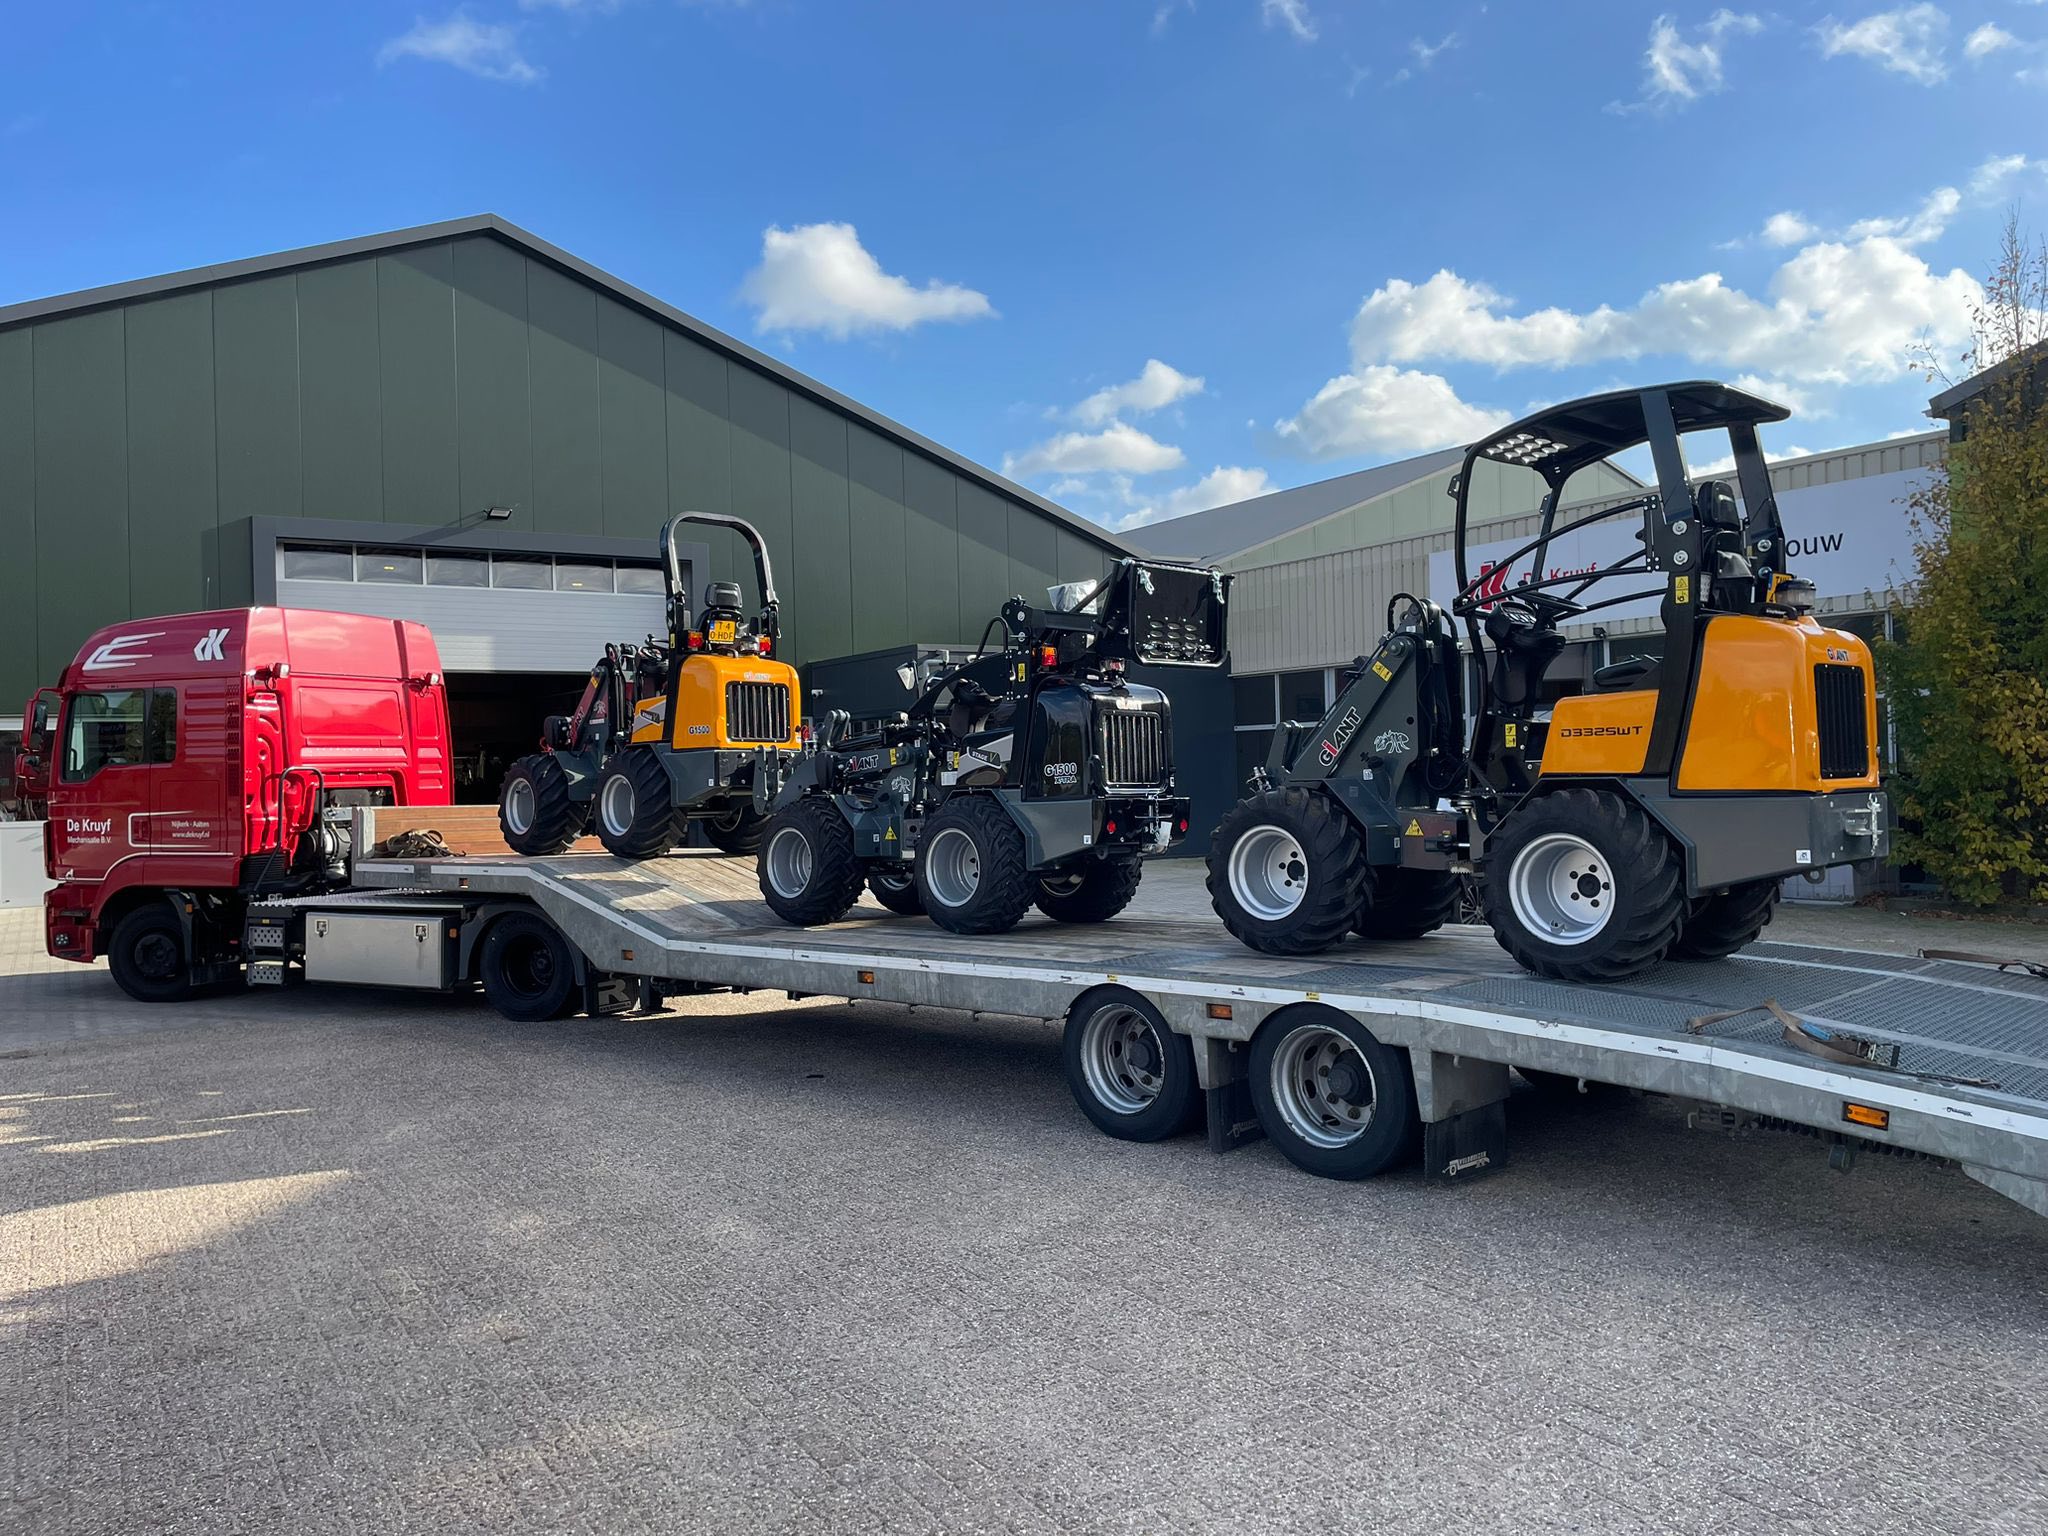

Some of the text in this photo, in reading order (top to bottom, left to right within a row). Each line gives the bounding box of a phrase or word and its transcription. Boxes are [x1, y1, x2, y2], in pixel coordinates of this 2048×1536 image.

[688, 725, 711, 735] G1500
[1318, 705, 1362, 767] GIANT
[1560, 725, 1643, 738] D332SWT
[971, 751, 989, 762] STAGE
[1044, 762, 1078, 777] G1500
[66, 818, 112, 835] De Kruyf
